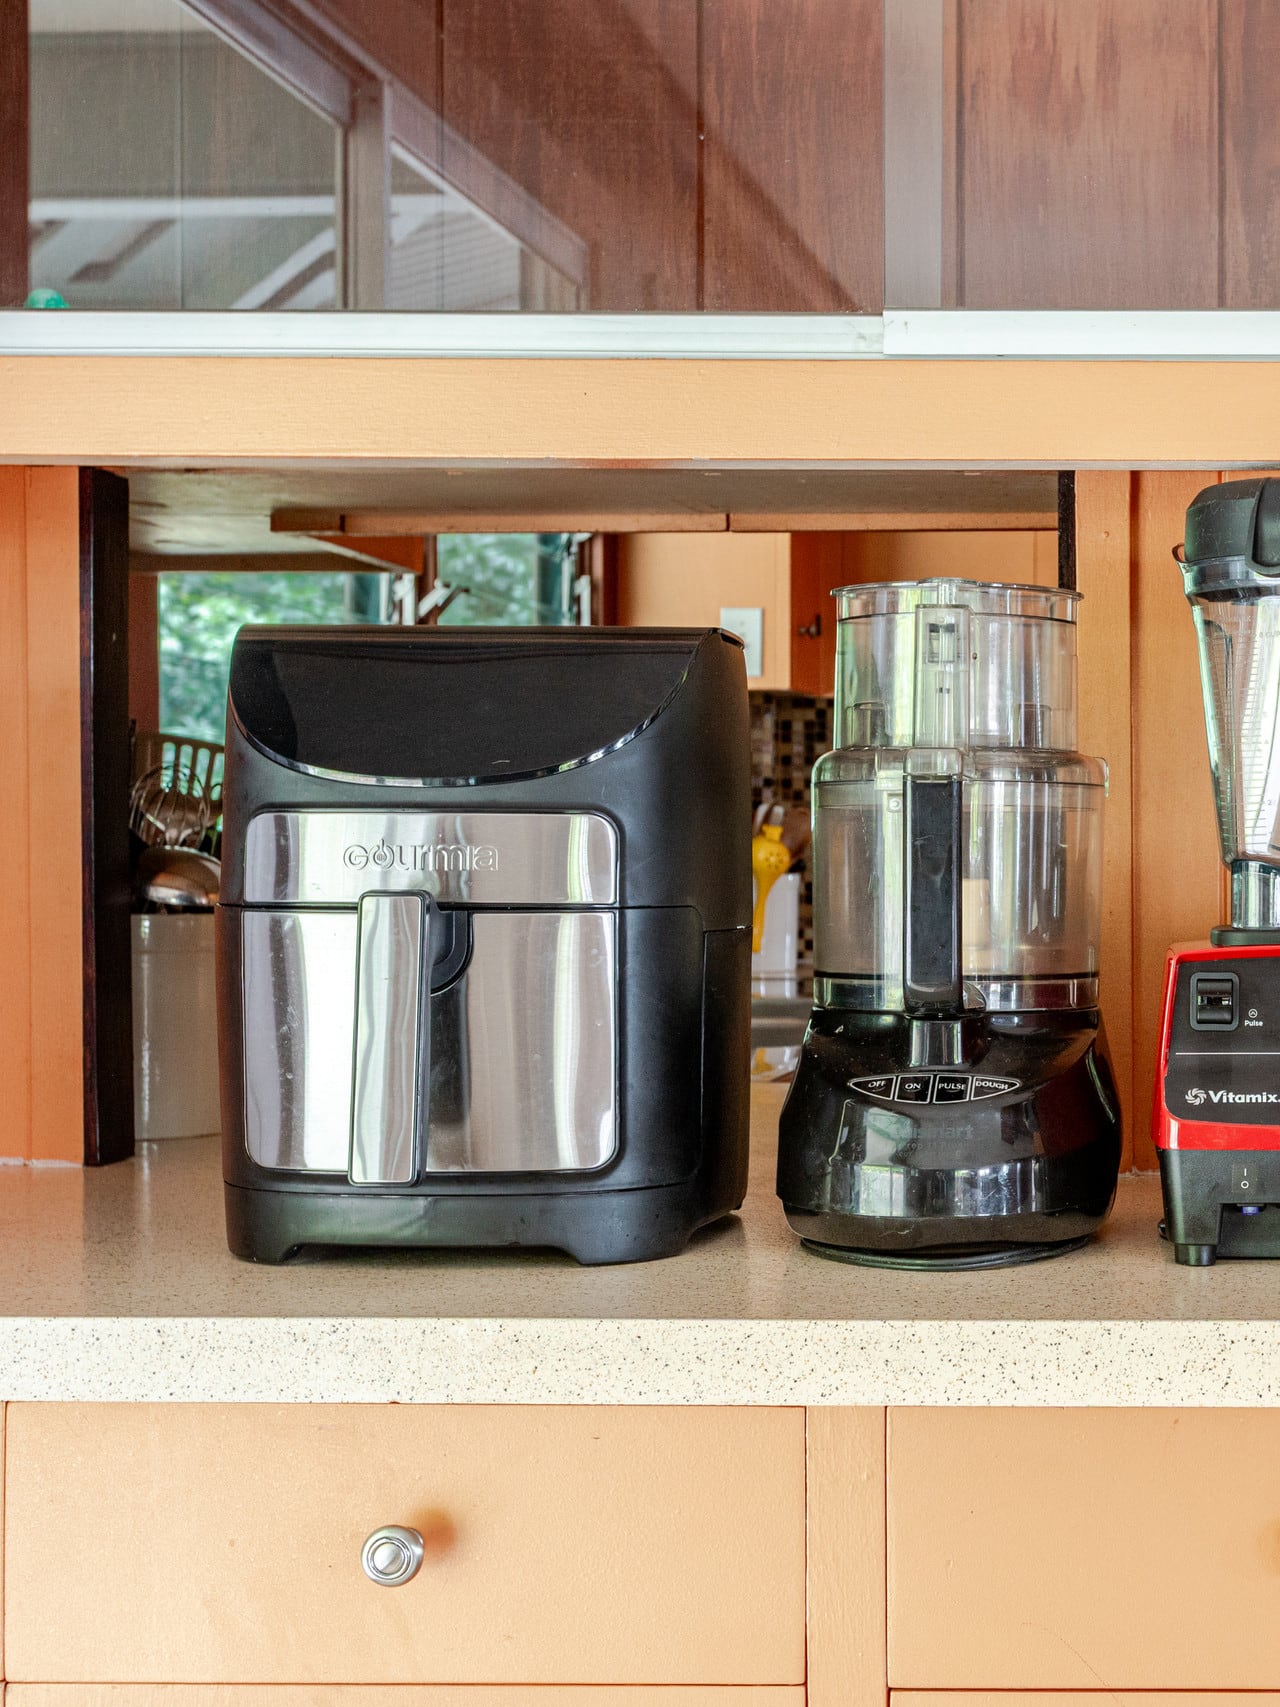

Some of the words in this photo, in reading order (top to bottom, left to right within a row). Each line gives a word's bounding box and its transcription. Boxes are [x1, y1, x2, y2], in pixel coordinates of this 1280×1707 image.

[1244, 1019, 1263, 1027] Pulse
[868, 1080, 886, 1088] OFF
[905, 1082, 922, 1090] ON
[975, 1080, 1009, 1090] DOUGH
